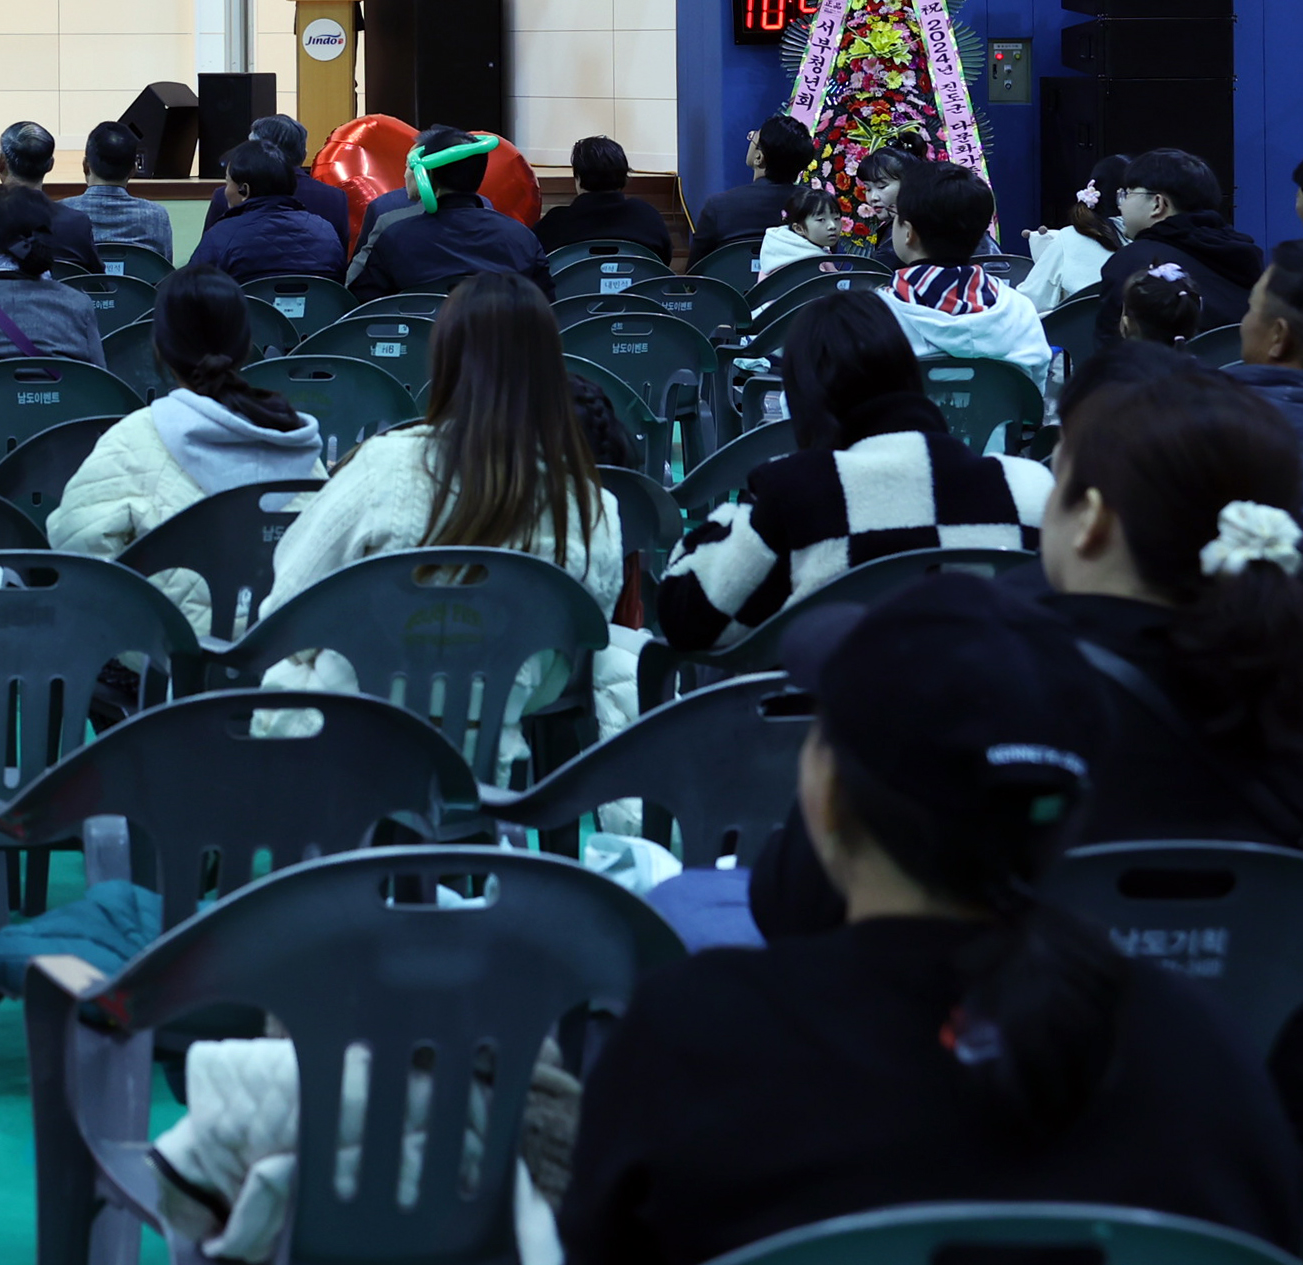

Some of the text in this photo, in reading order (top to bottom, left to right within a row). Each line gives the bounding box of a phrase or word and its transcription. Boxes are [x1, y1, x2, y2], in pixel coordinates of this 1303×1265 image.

[305, 36, 338, 46] Jindo
[926, 19, 954, 76] 2024년
[795, 19, 836, 112] 서부청년회
[612, 342, 649, 354] 남도이벤트
[17, 392, 61, 404] 남도이벤트
